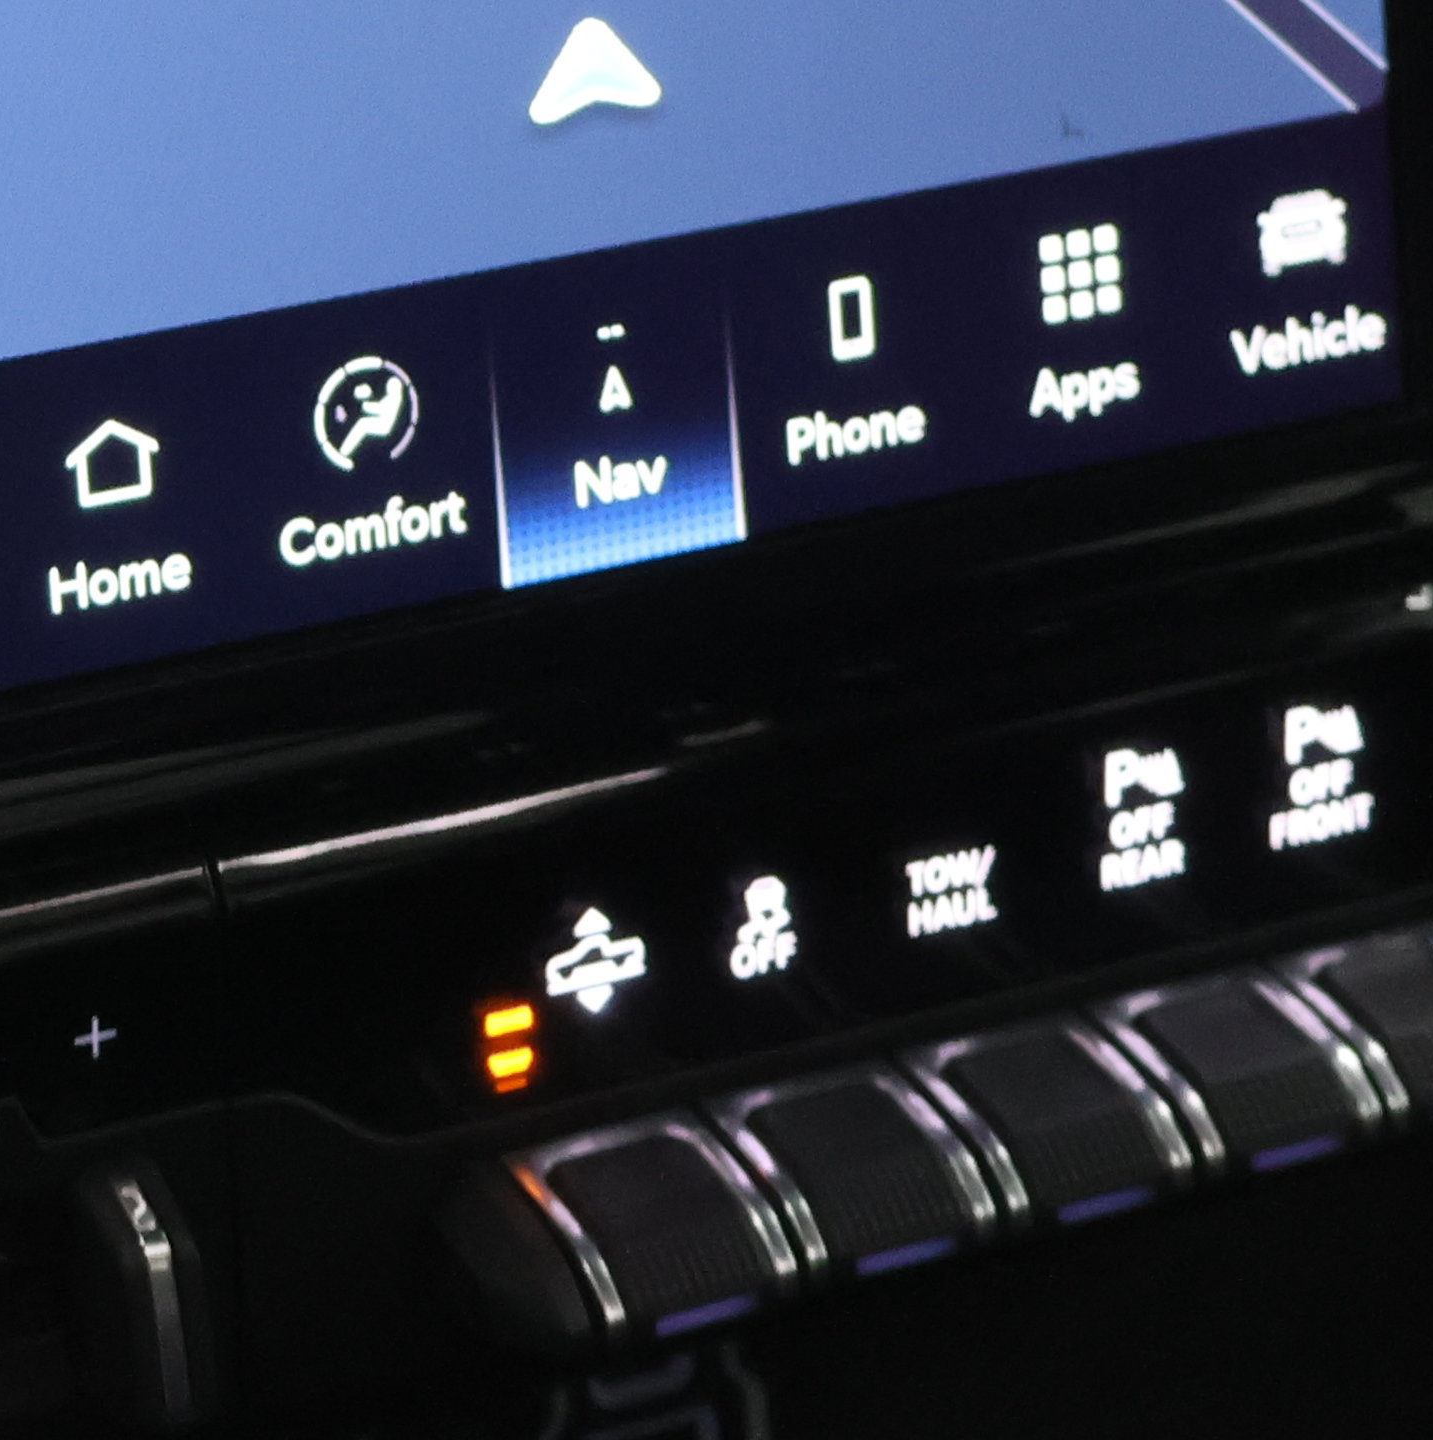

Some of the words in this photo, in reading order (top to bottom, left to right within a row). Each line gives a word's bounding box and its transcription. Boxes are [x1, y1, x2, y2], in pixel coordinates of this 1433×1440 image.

[1229, 303, 1387, 377] Vehicle
[1028, 360, 1140, 422] Apps
[786, 402, 925, 466] Phone
[573, 454, 668, 509] Nav
[279, 490, 468, 568] Comfort
[48, 551, 192, 617] Home
[1288, 758, 1354, 806] OFF
[1109, 801, 1175, 849] OFF
[1269, 792, 1375, 851] FRONT
[905, 844, 997, 897] TOW/
[1100, 838, 1186, 892] REAR
[907, 886, 998, 938] HAUL
[730, 930, 797, 980] OFF
